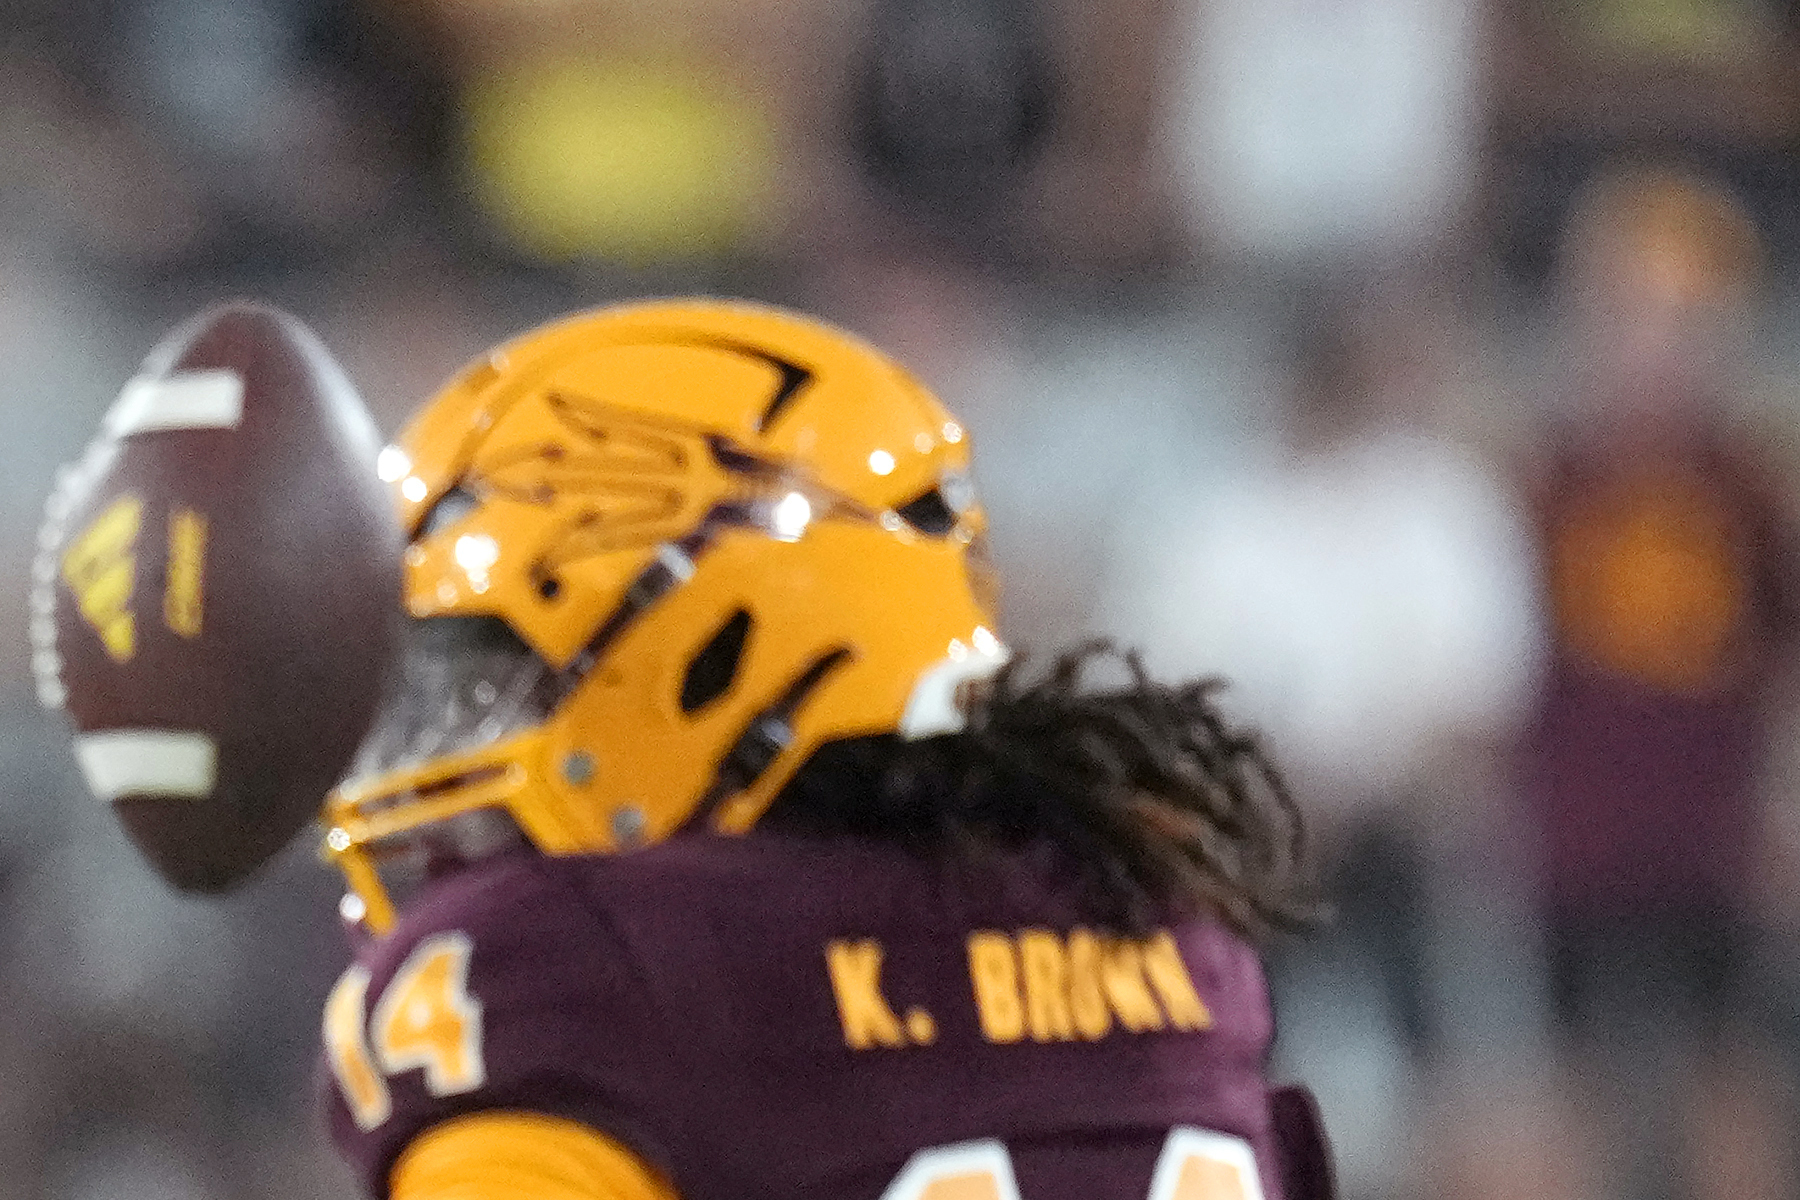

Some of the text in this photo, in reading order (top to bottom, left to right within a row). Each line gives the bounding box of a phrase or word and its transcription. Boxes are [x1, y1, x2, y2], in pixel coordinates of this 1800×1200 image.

[322, 930, 487, 1134] 14
[826, 926, 1214, 1050] K. BROWN
